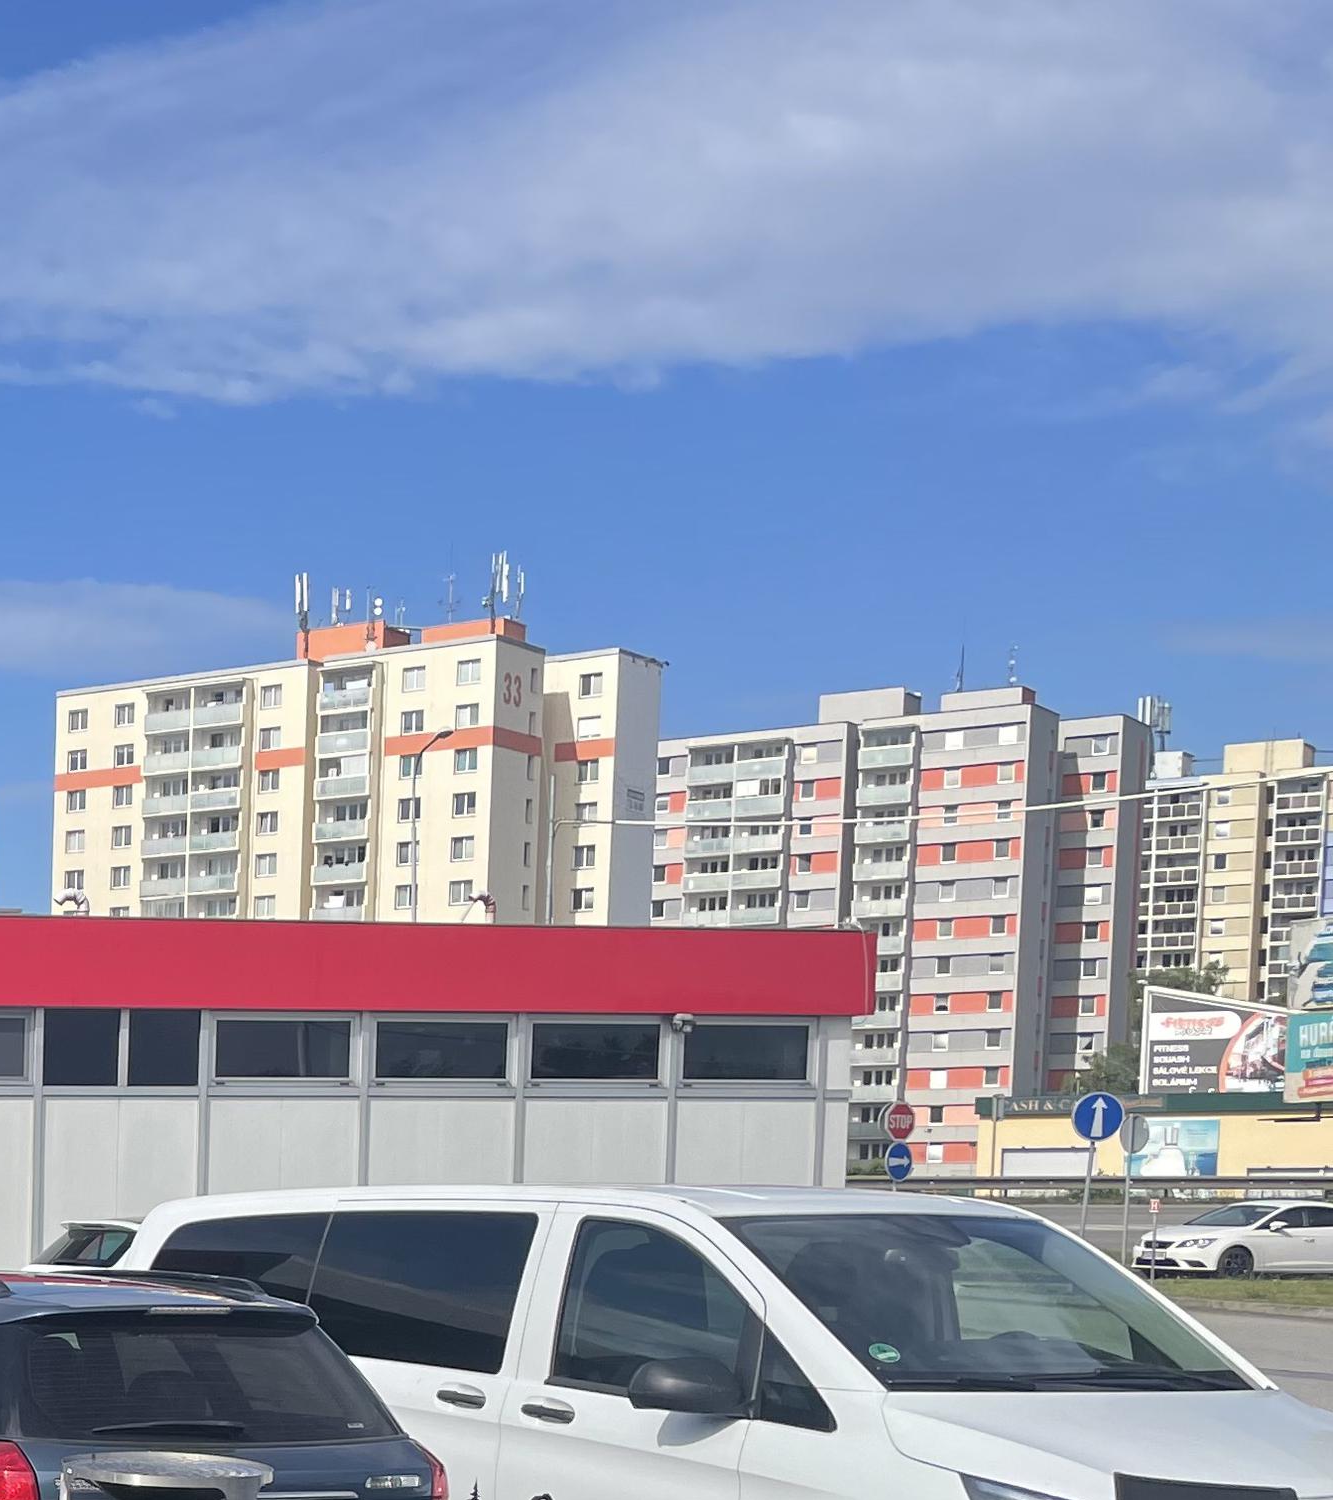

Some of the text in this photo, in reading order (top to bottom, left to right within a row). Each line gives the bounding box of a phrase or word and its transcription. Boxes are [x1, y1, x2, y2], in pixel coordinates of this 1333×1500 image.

[503, 672, 522, 707] 33
[1153, 1044, 1190, 1053] FITNESS
[1153, 1055, 1190, 1064] SQUASH
[1189, 1065, 1218, 1075] LEKCE
[889, 1114, 913, 1129] STOP
